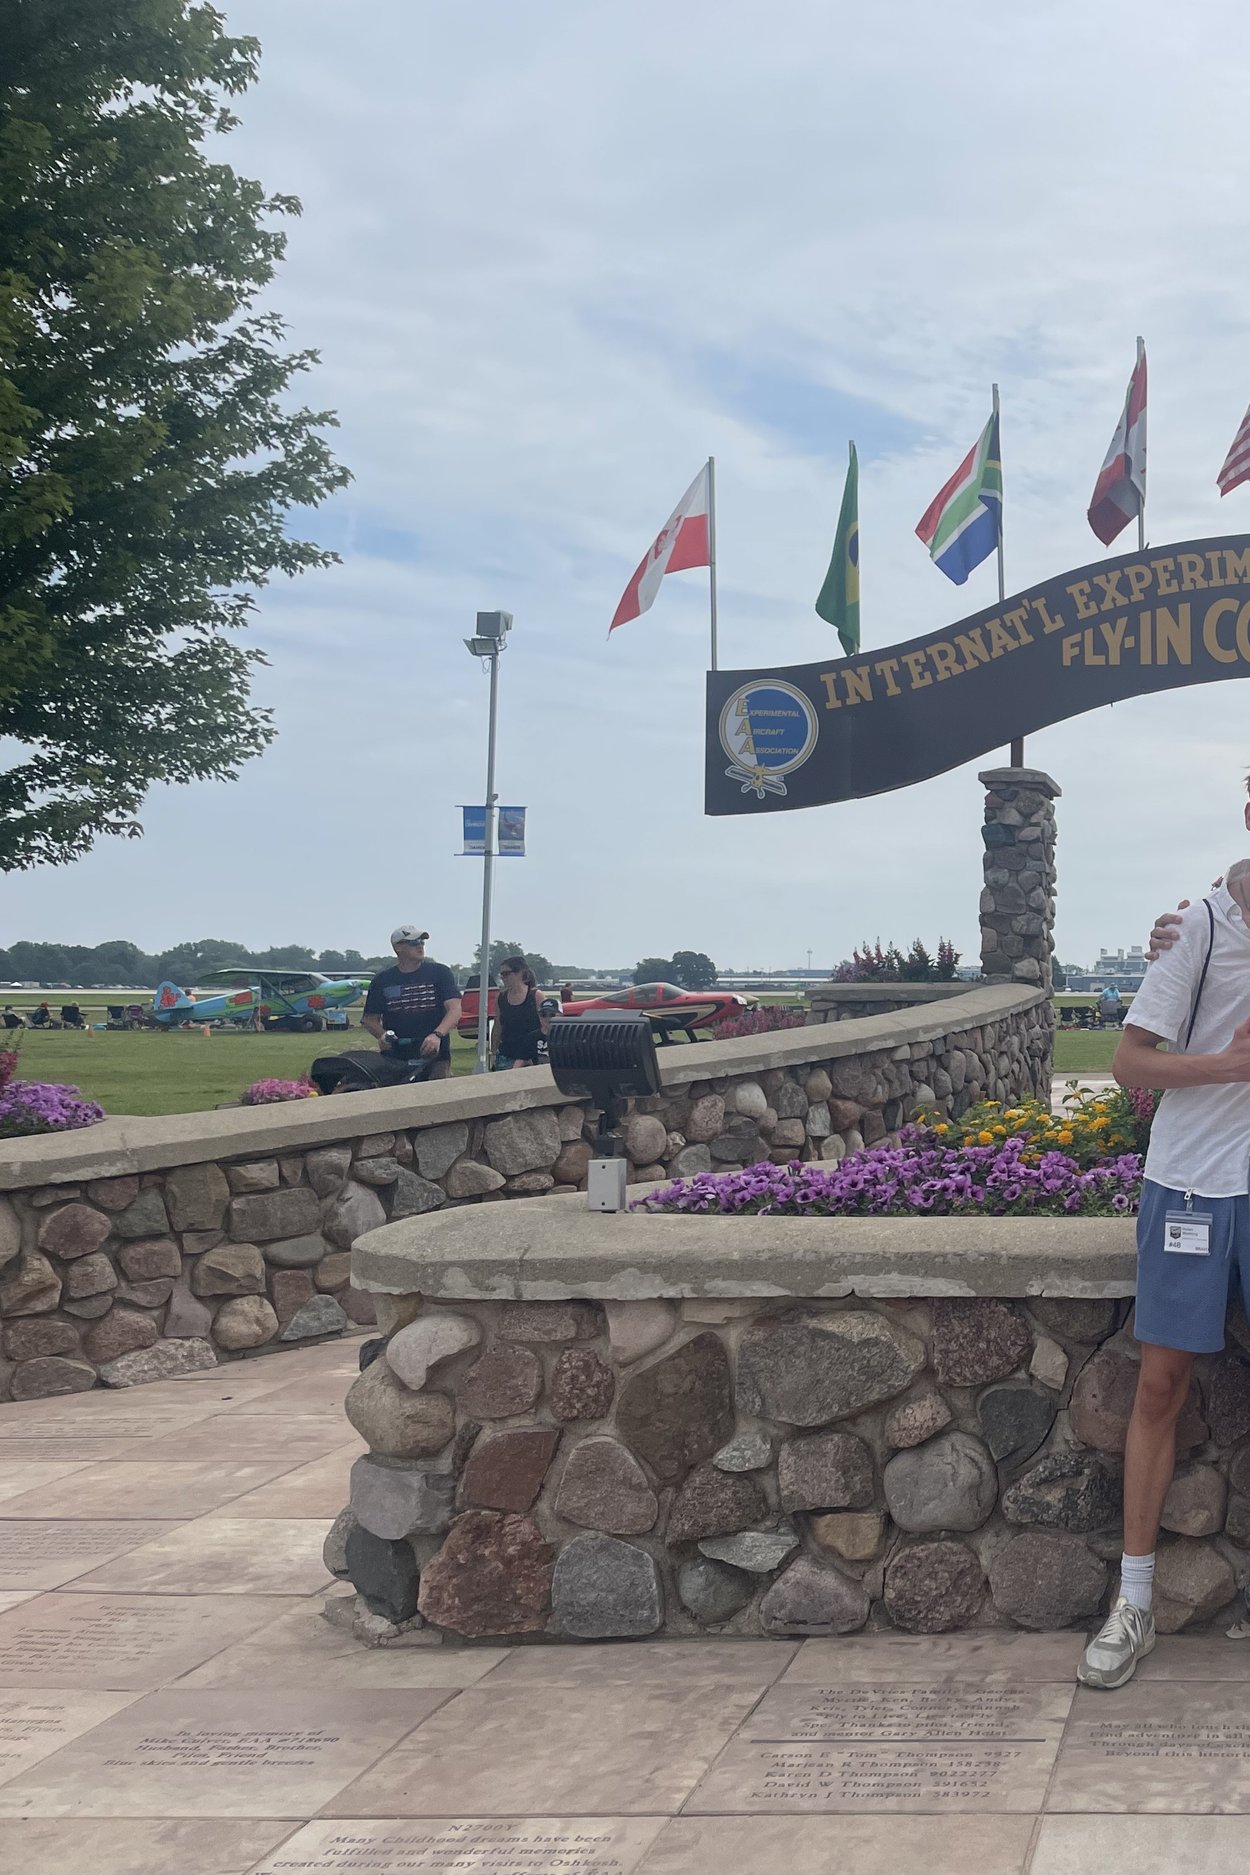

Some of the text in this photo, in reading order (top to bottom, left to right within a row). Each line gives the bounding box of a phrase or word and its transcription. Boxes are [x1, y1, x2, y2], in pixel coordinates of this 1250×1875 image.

[1062, 602, 1191, 666] FLY-IN
[820, 597, 1065, 709] INTERNAT'L
[330, 1836, 611, 1844] Many Childhood dreams have been
[273, 1860, 331, 1869] created
[339, 1860, 392, 1869] during
[397, 1860, 425, 1869] our
[431, 1860, 475, 1869] many
[482, 1860, 522, 1869] visits
[527, 1860, 544, 1869] to
